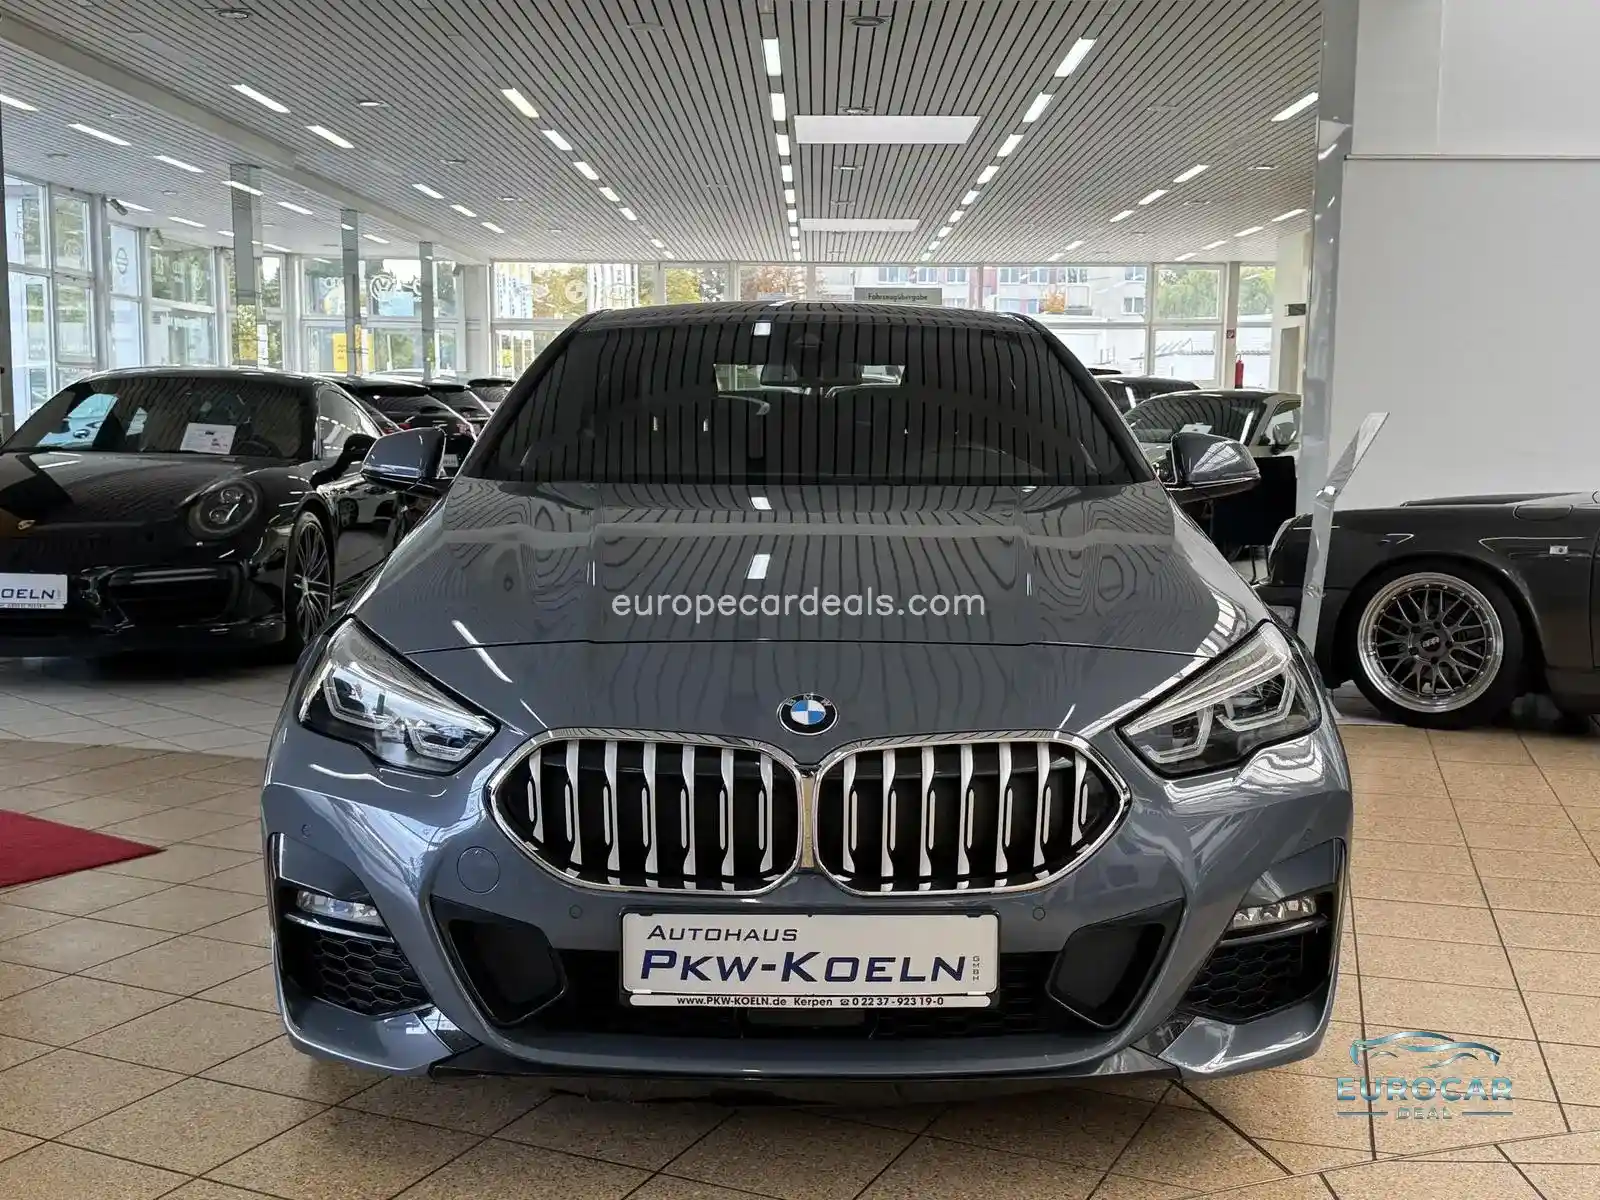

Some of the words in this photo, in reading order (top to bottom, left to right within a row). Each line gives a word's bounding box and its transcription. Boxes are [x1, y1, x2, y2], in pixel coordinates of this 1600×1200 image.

[0, 588, 55, 599] OELN
[647, 924, 798, 942] AUTOHAUS
[640, 949, 966, 983] PKW-KOELN
[677, 996, 787, 1006] www.PKW-KOELN.de
[794, 997, 833, 1008] Kerpen
